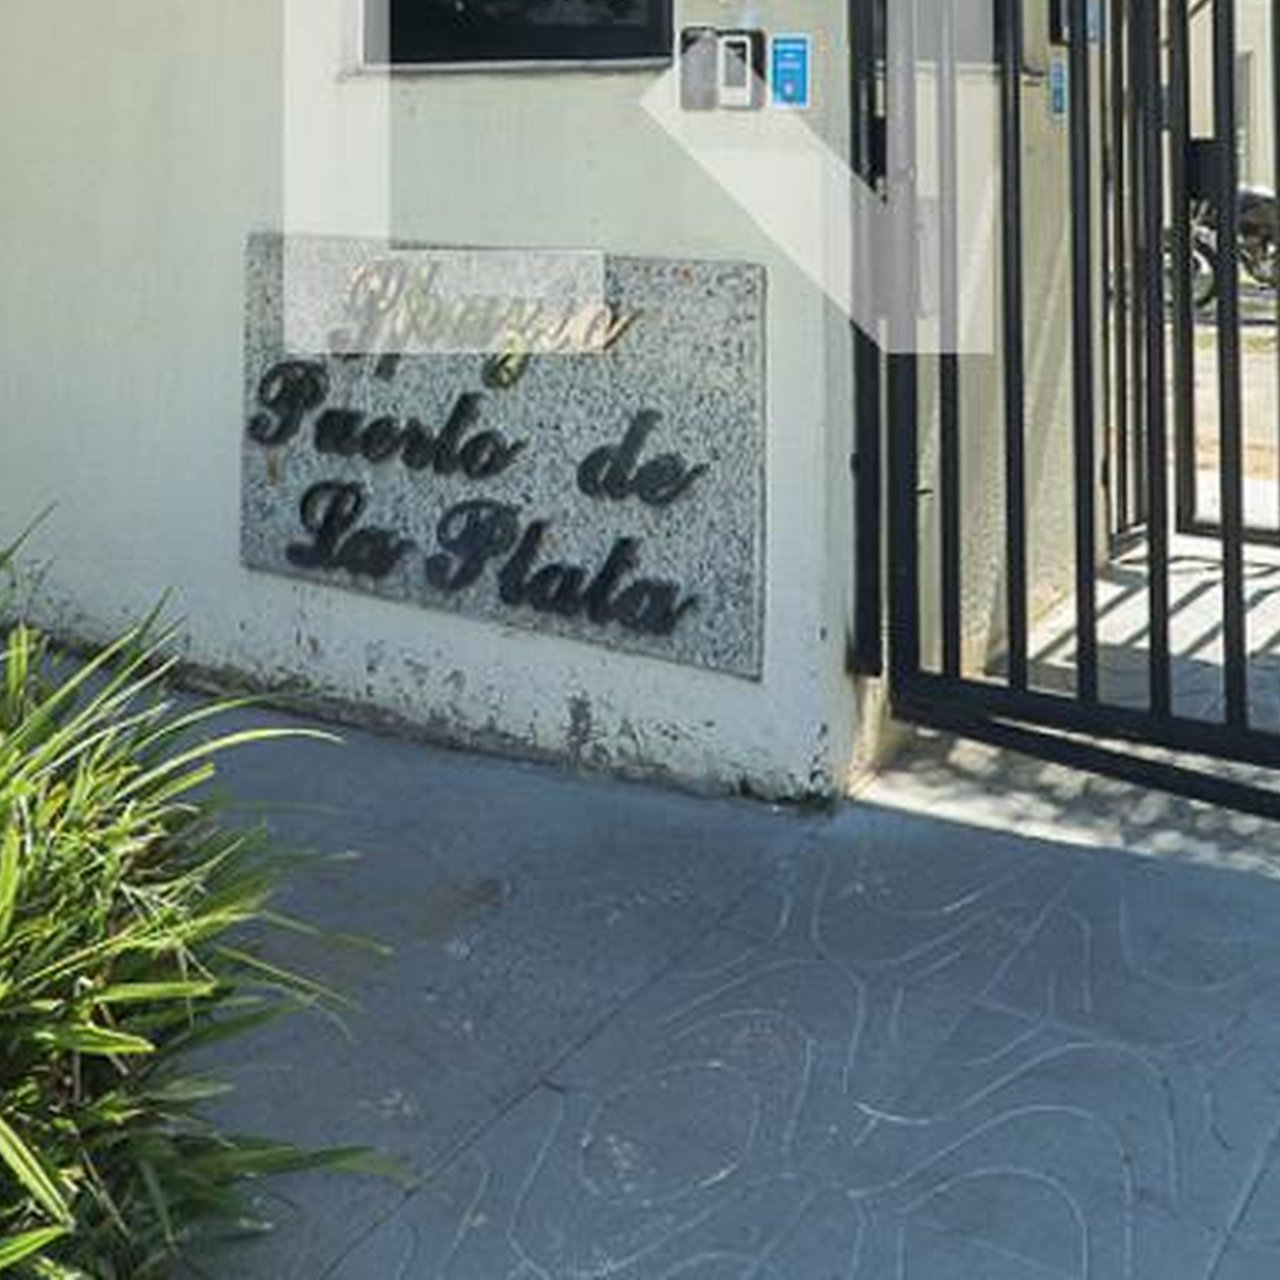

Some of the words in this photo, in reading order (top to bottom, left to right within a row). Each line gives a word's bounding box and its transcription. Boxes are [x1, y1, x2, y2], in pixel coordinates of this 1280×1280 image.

[248, 359, 529, 480] Puerto
[576, 409, 710, 506] de
[286, 480, 417, 578] La
[426, 498, 699, 636] Plata
